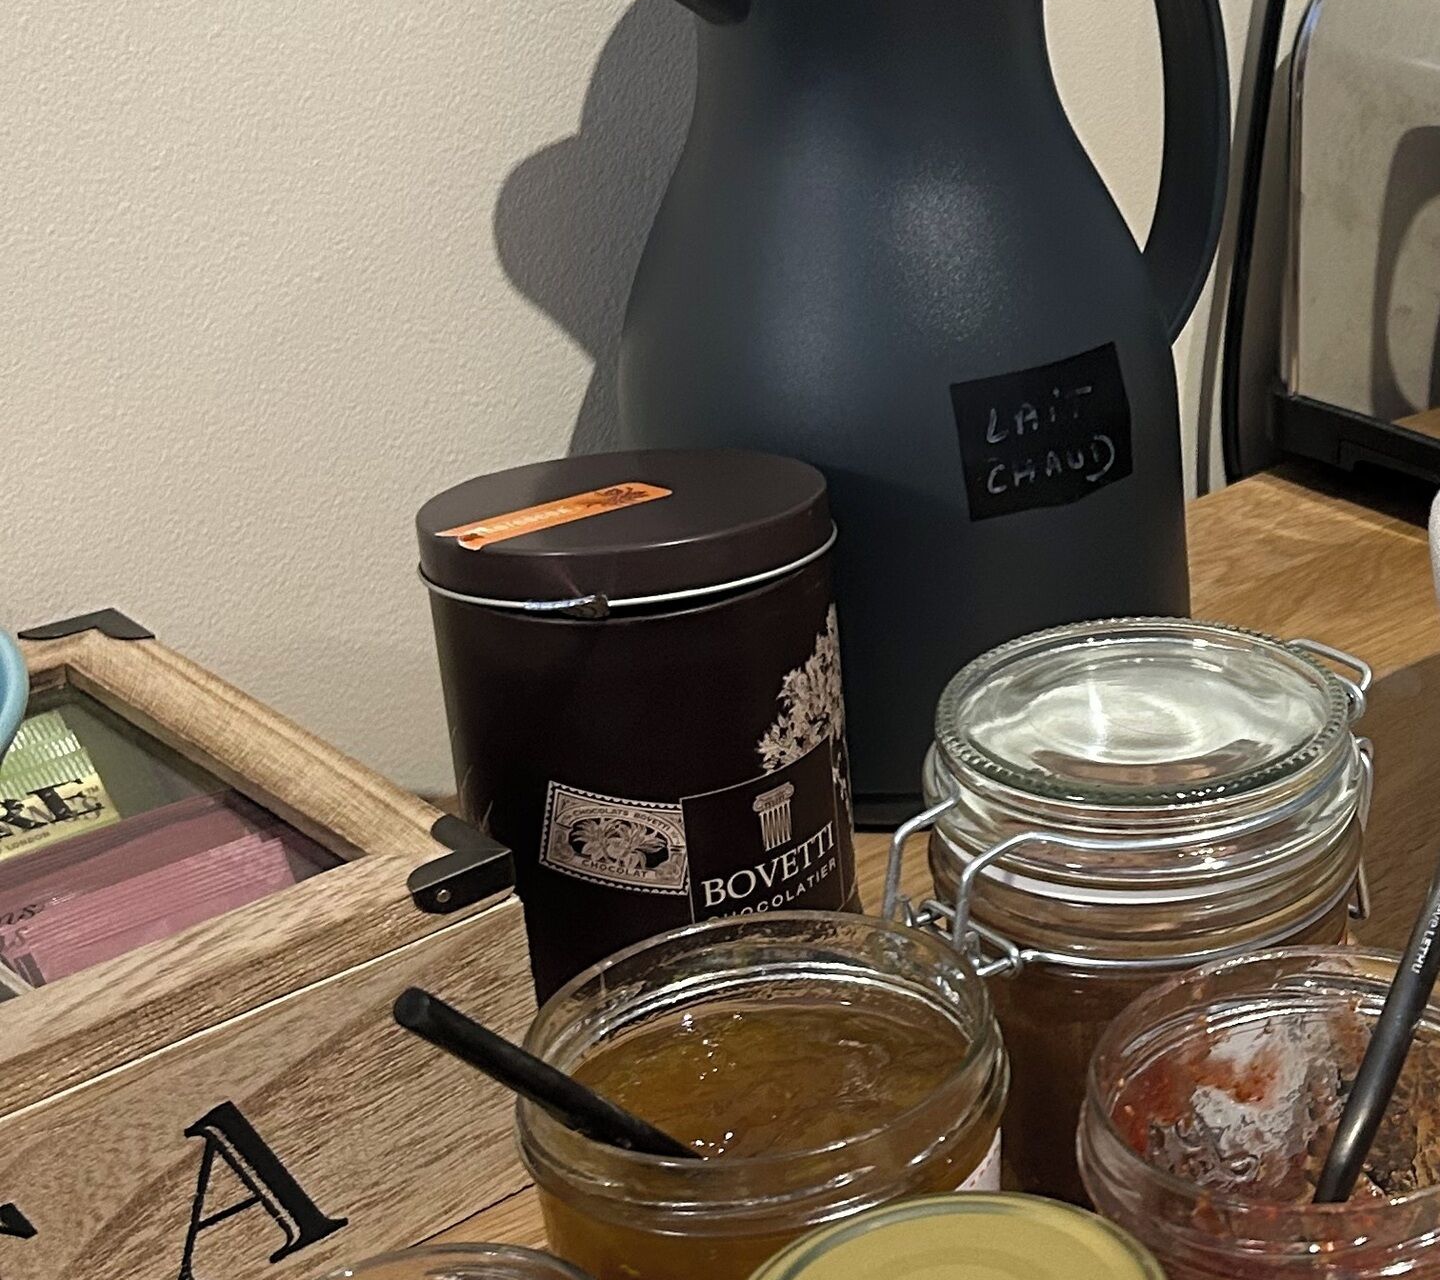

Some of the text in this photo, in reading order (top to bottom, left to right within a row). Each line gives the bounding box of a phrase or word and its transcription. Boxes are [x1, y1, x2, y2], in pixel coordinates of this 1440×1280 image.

[987, 434, 1116, 495] CHAUD
[581, 859, 648, 878] CHOCOLAT
[701, 820, 834, 907] BOVETTI
[706, 857, 838, 921] OCOLATIER
